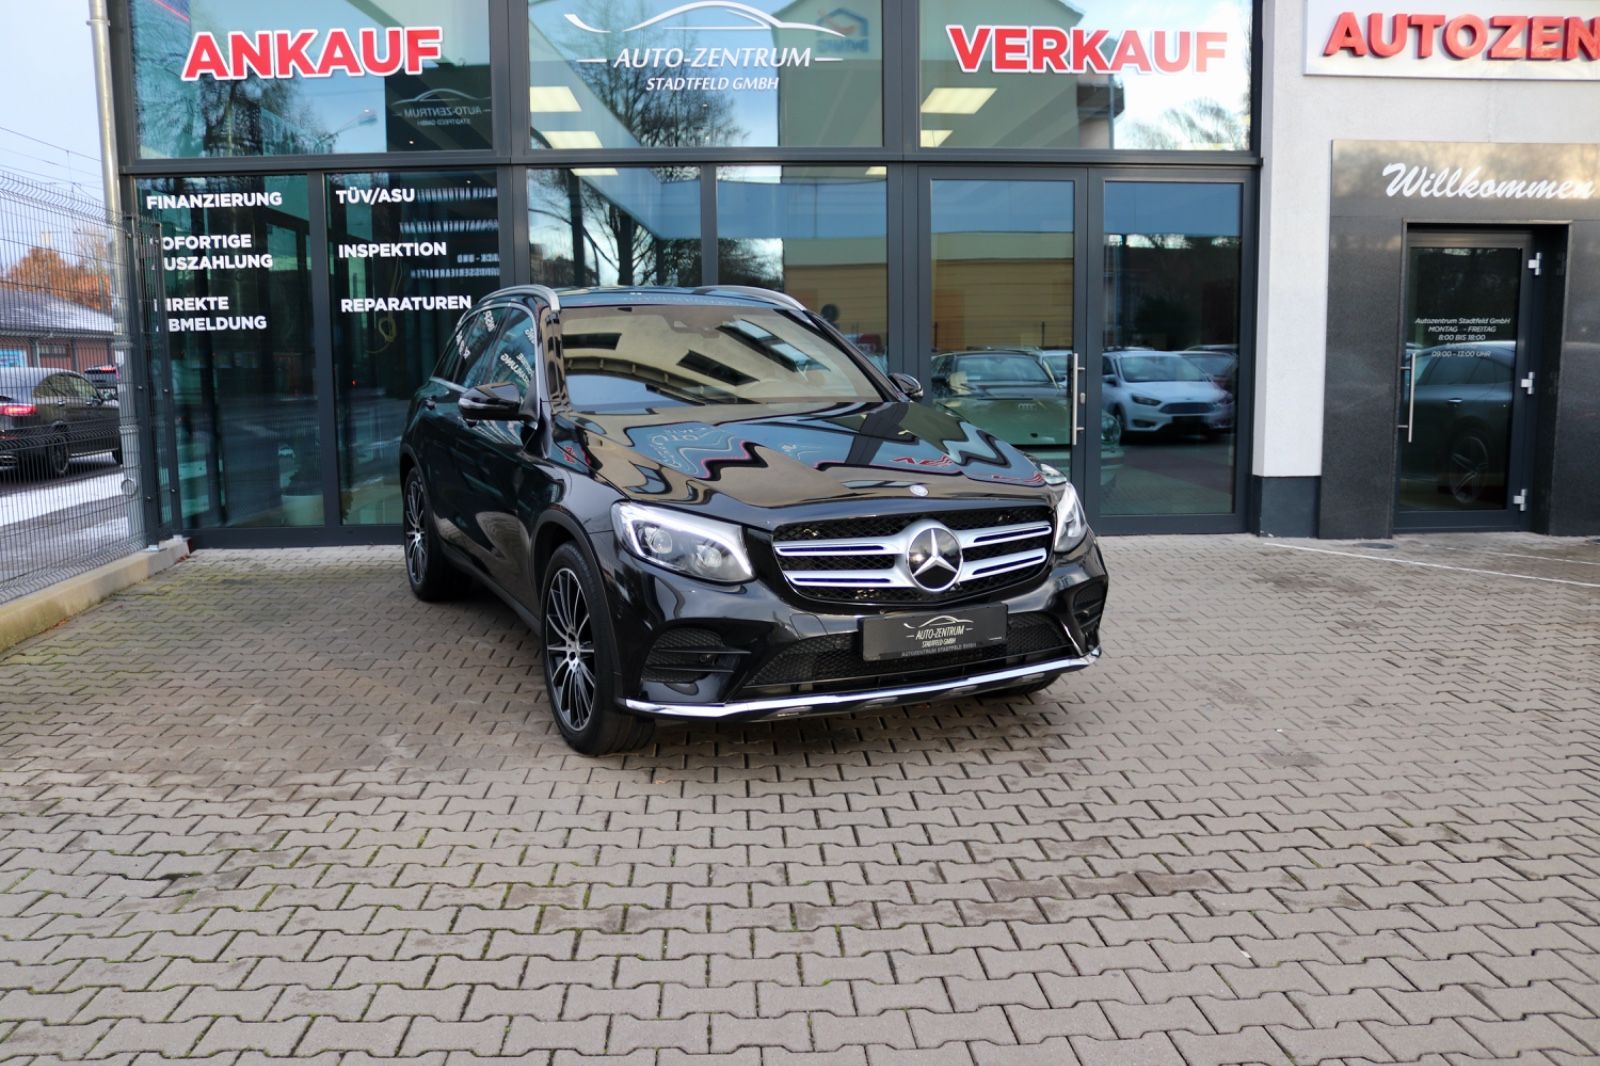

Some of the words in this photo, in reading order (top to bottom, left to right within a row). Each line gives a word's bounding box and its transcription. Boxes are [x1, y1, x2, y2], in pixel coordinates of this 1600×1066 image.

[1322, 11, 1600, 61] AUTOZEN
[181, 26, 443, 81] ANKAUF
[612, 47, 812, 69] AUTO-ZENTRUM
[945, 24, 1230, 74] VERKAUF
[645, 77, 730, 92] STADTFELD
[732, 76, 780, 91] GMBH
[1382, 162, 1595, 200] Willkommen
[146, 192, 283, 210] FINANZIERUNG
[335, 187, 416, 206] TÜV/ASU
[149, 234, 252, 251] OFORTIGE
[338, 241, 448, 259] INSPEKTION
[152, 254, 274, 271] USZAHLUNG
[153, 296, 230, 312] IREKTE
[340, 295, 472, 313] REPARATUREN
[155, 315, 268, 333] BMELDUNG
[1458, 317, 1489, 325] Stadtfeld
[916, 625, 965, 640] AUTO-ZENTRUM
